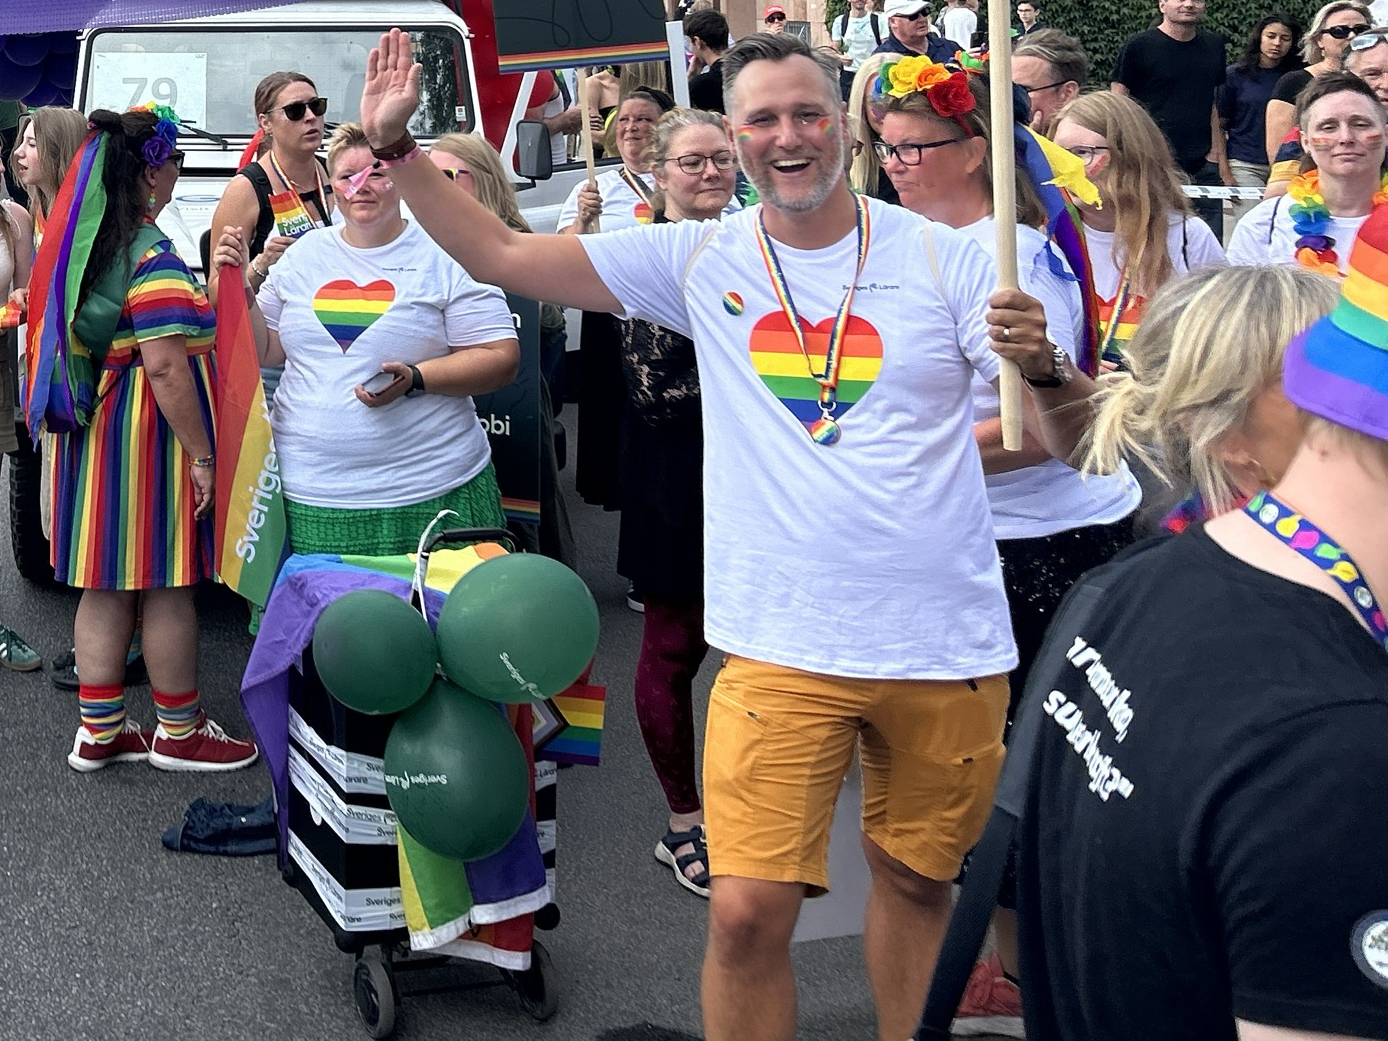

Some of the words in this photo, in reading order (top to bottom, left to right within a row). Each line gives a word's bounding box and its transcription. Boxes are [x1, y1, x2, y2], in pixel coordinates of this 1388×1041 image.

[122, 77, 178, 114] 79
[346, 807, 382, 822] Sveriges
[365, 896, 401, 907] Sveriges
